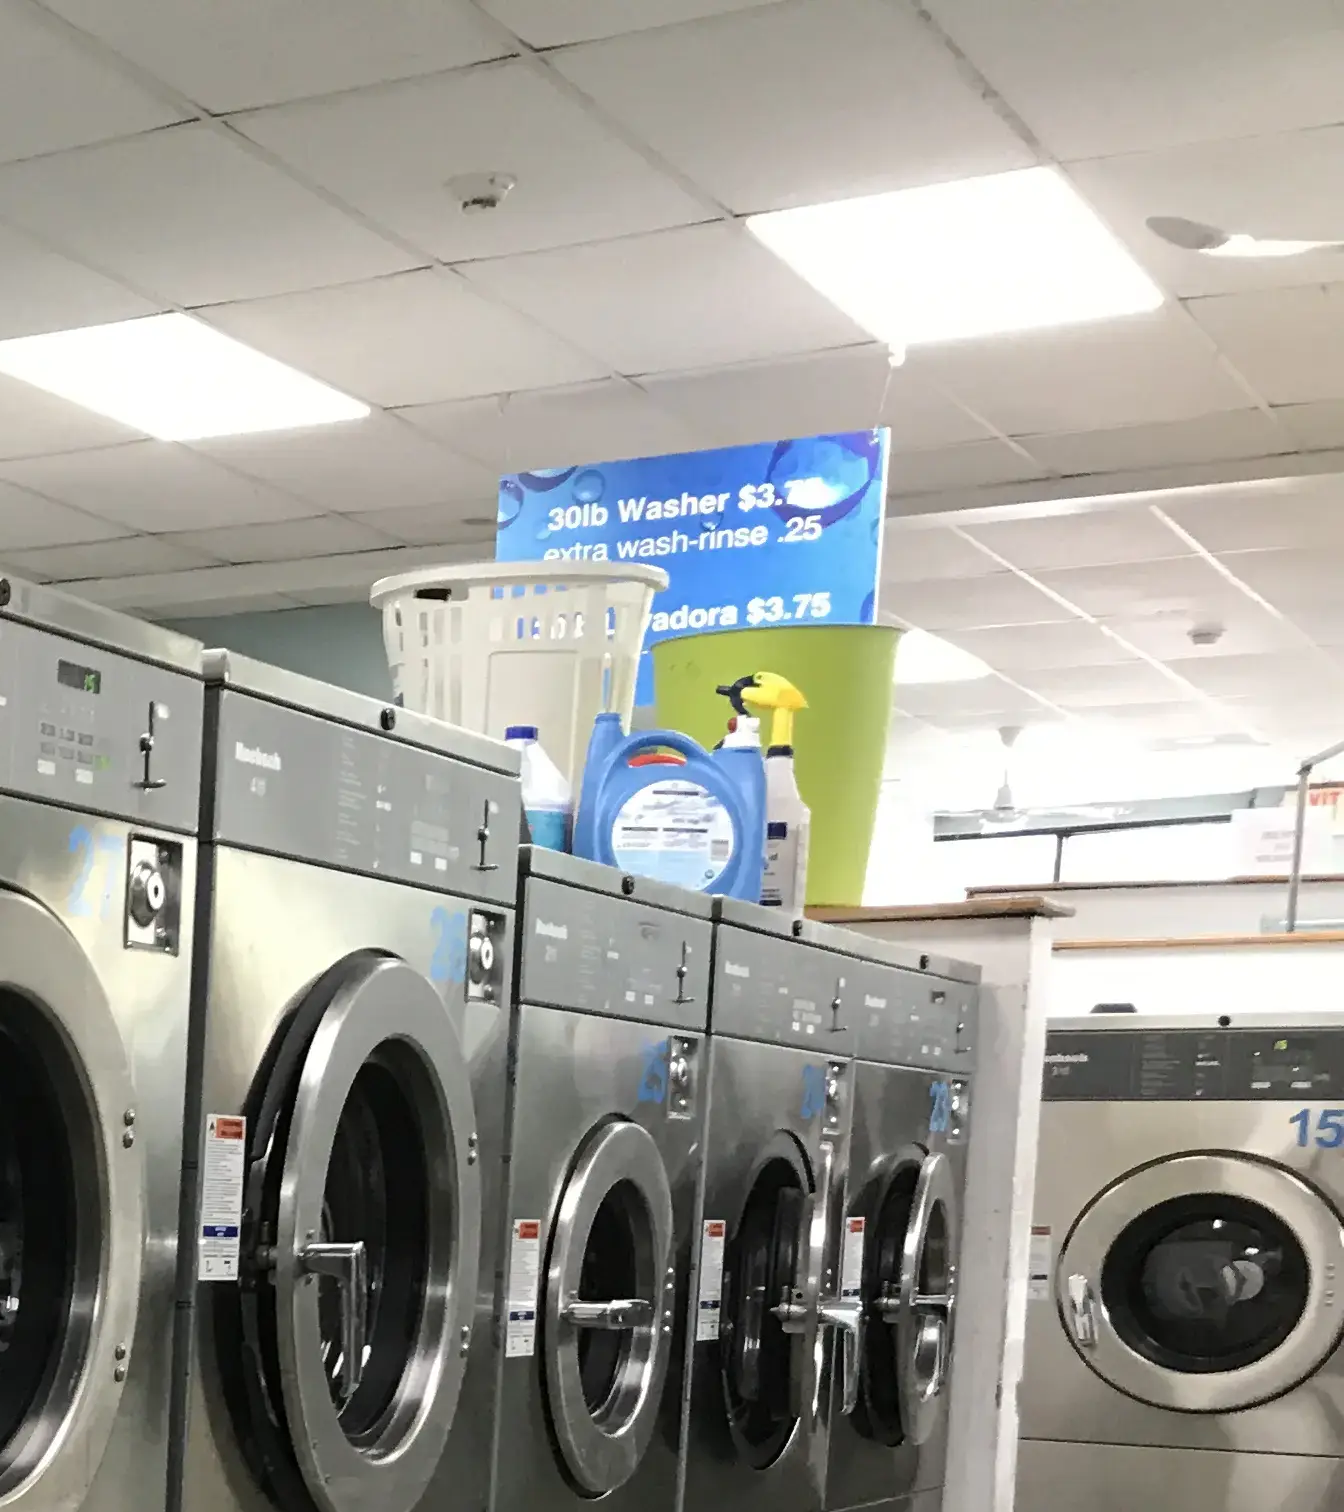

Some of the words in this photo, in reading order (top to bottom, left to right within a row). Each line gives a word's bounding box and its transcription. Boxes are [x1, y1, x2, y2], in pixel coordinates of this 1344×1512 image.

[547, 503, 609, 532] 30lb
[617, 489, 730, 524] Washer
[738, 477, 824, 512] $3.7
[543, 541, 609, 562] extra
[616, 526, 769, 559] wash-rinse
[777, 515, 823, 543] .25
[746, 592, 832, 625] $3.75
[1288, 1108, 1344, 1148] 15
